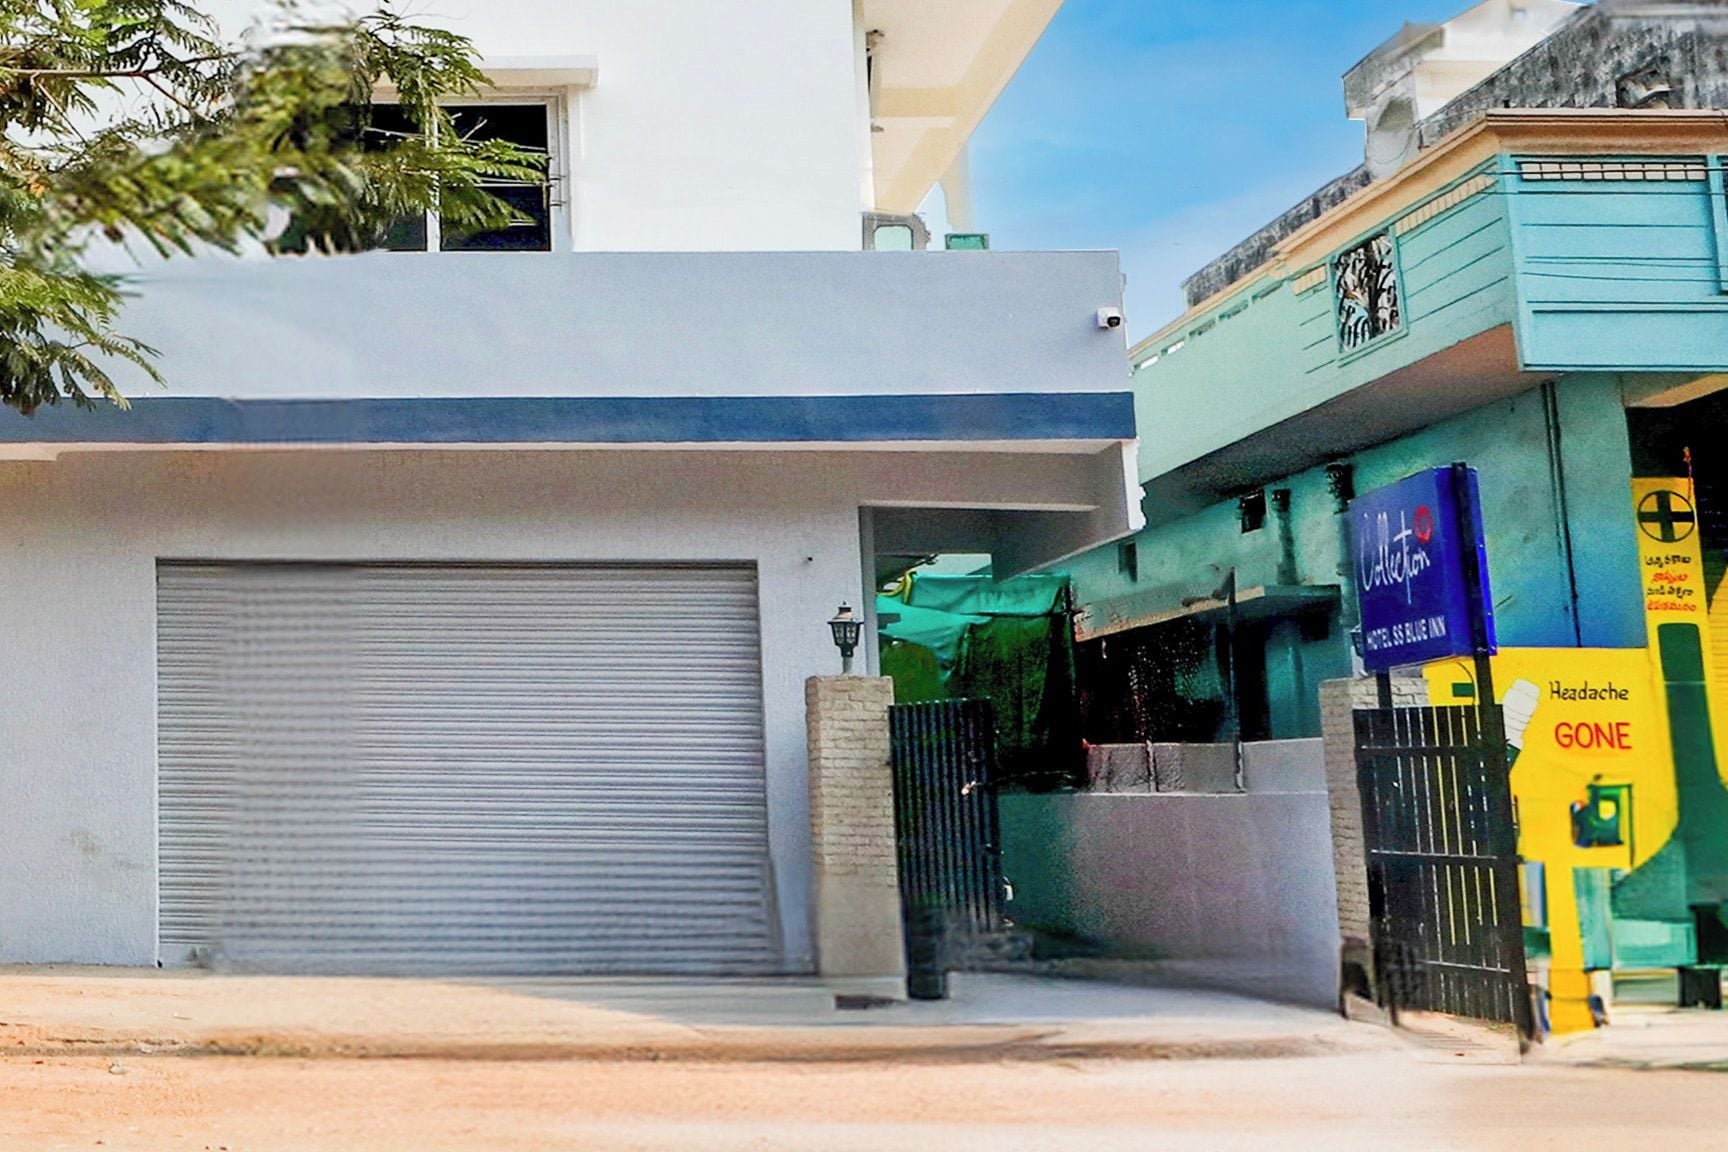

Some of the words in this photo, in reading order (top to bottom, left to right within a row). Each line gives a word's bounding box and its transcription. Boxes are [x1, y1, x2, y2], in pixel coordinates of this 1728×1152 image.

[1360, 510, 1431, 605] Collection
[1366, 627, 1392, 650] HOTEL
[1392, 623, 1404, 646] SS
[1404, 618, 1428, 643] BLUE
[1428, 615, 1446, 638] INN
[1549, 680, 1630, 701] Headache
[1554, 721, 1633, 750] GONE
